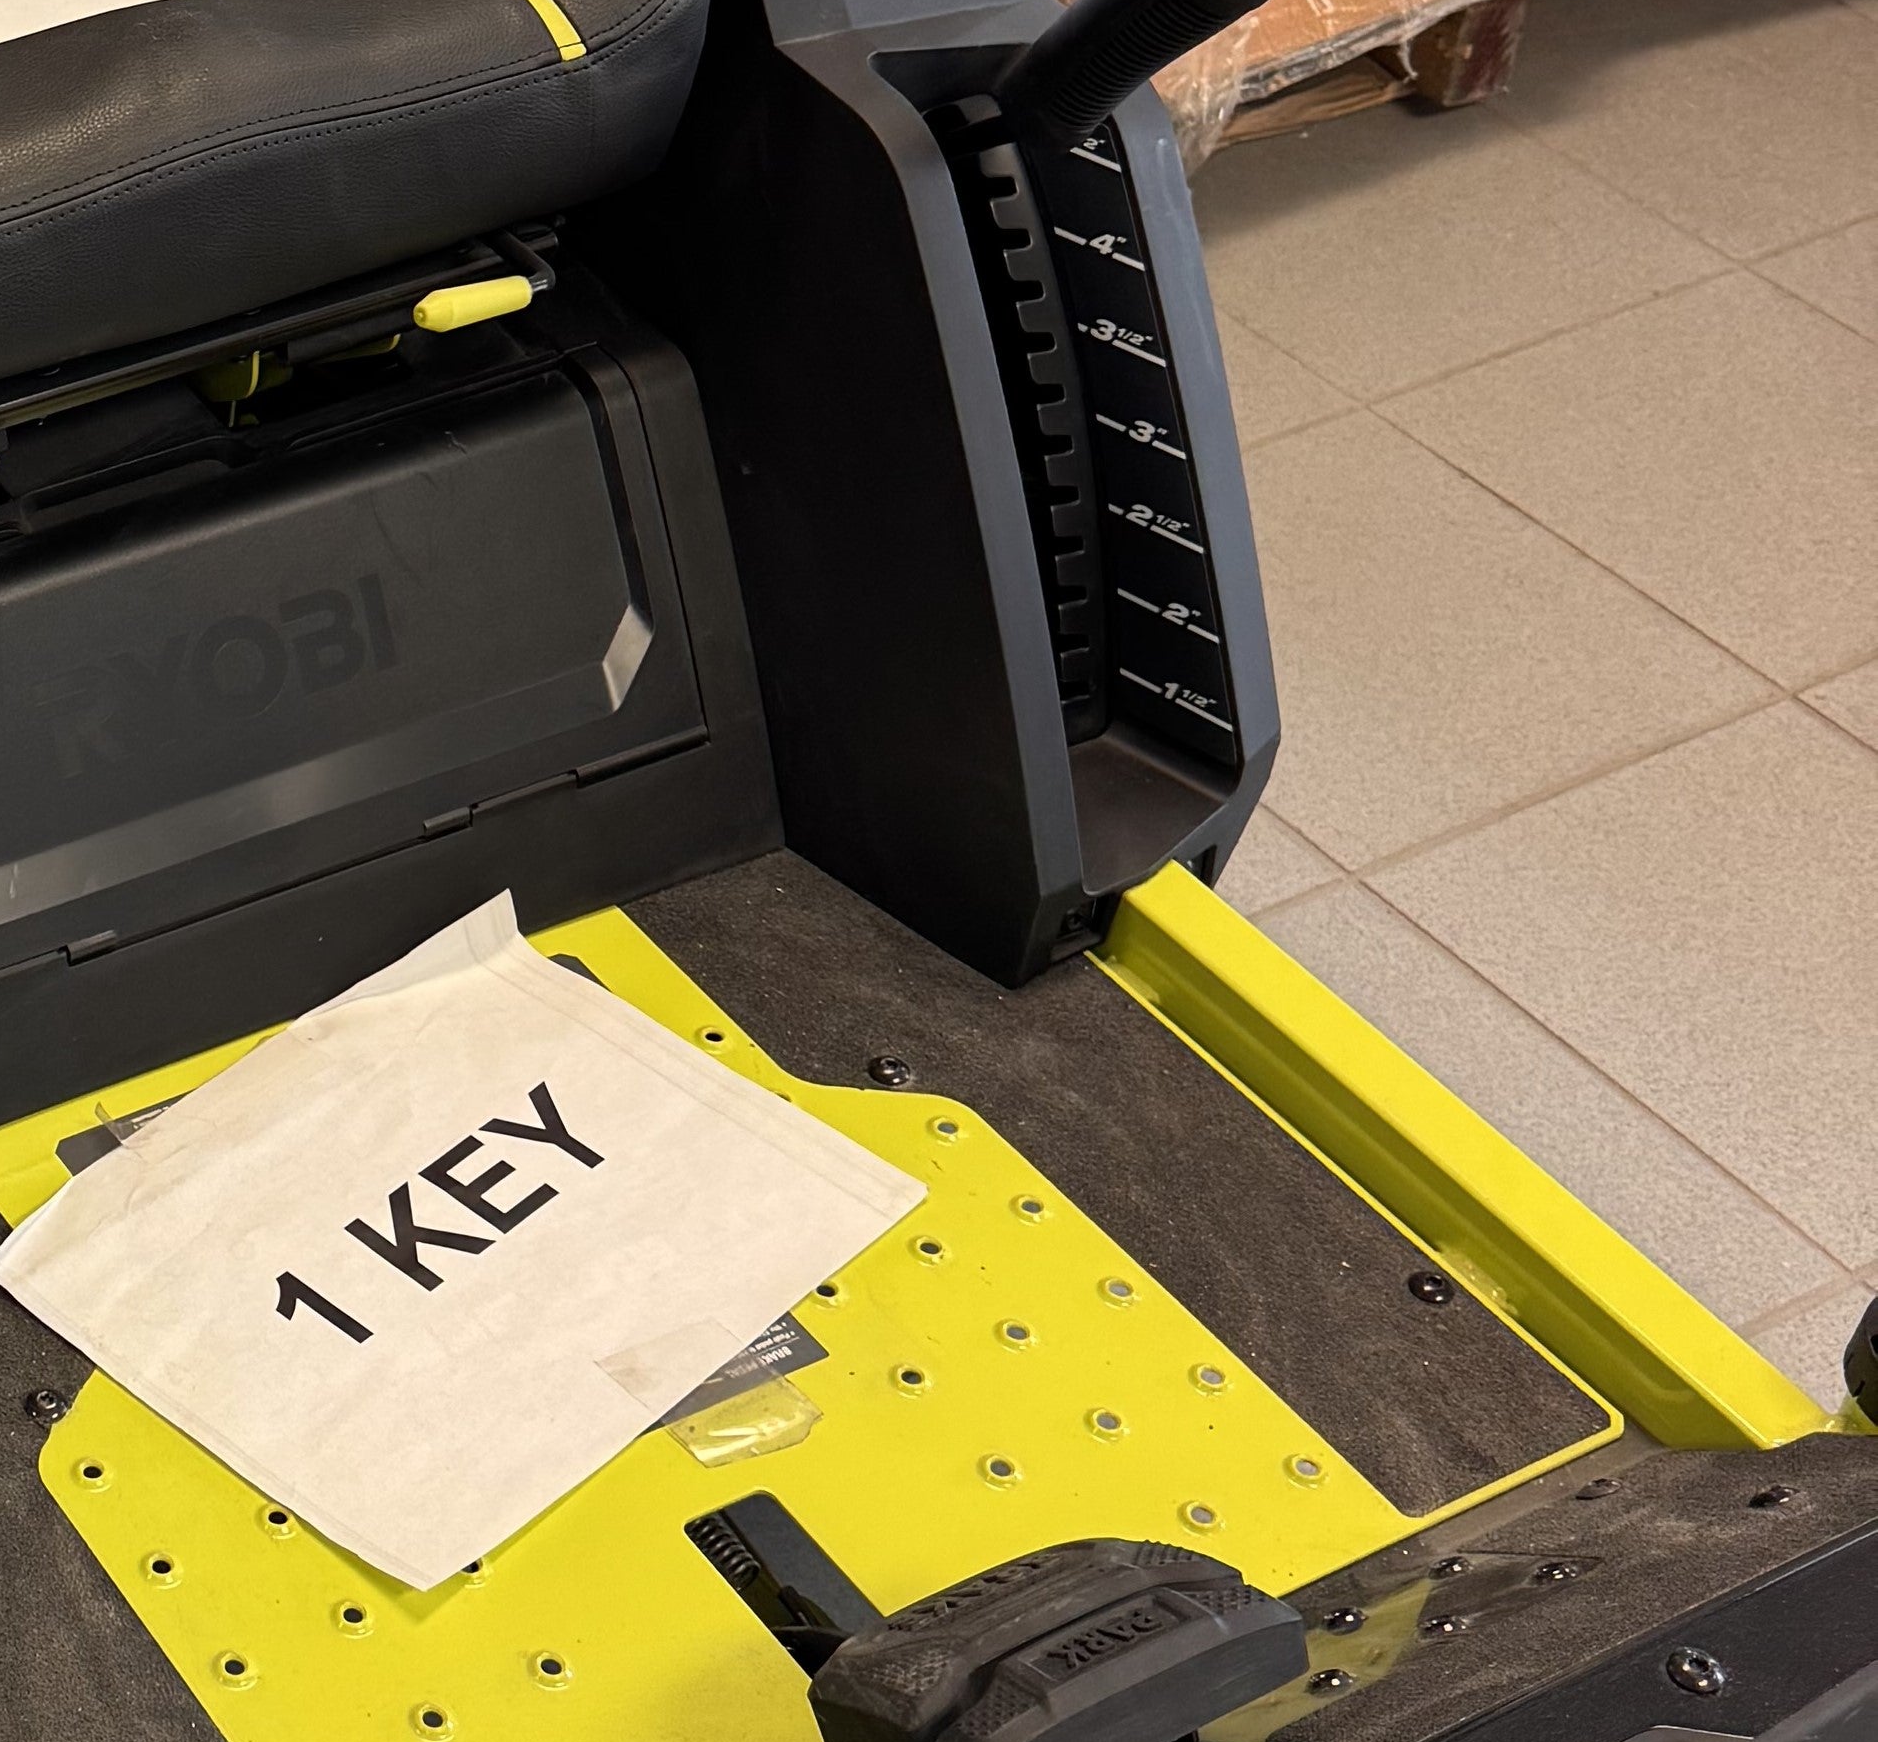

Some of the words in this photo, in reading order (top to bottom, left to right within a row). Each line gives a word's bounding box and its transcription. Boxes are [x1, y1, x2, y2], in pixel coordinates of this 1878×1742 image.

[1089, 233, 1128, 255] 4"
[1128, 420, 1169, 443] 3"
[1161, 602, 1202, 626] 2"
[28, 573, 401, 780] RYOBI
[273, 1269, 375, 1345] 1
[343, 1079, 606, 1293] KEY
[1046, 1609, 1163, 1670] PARK
